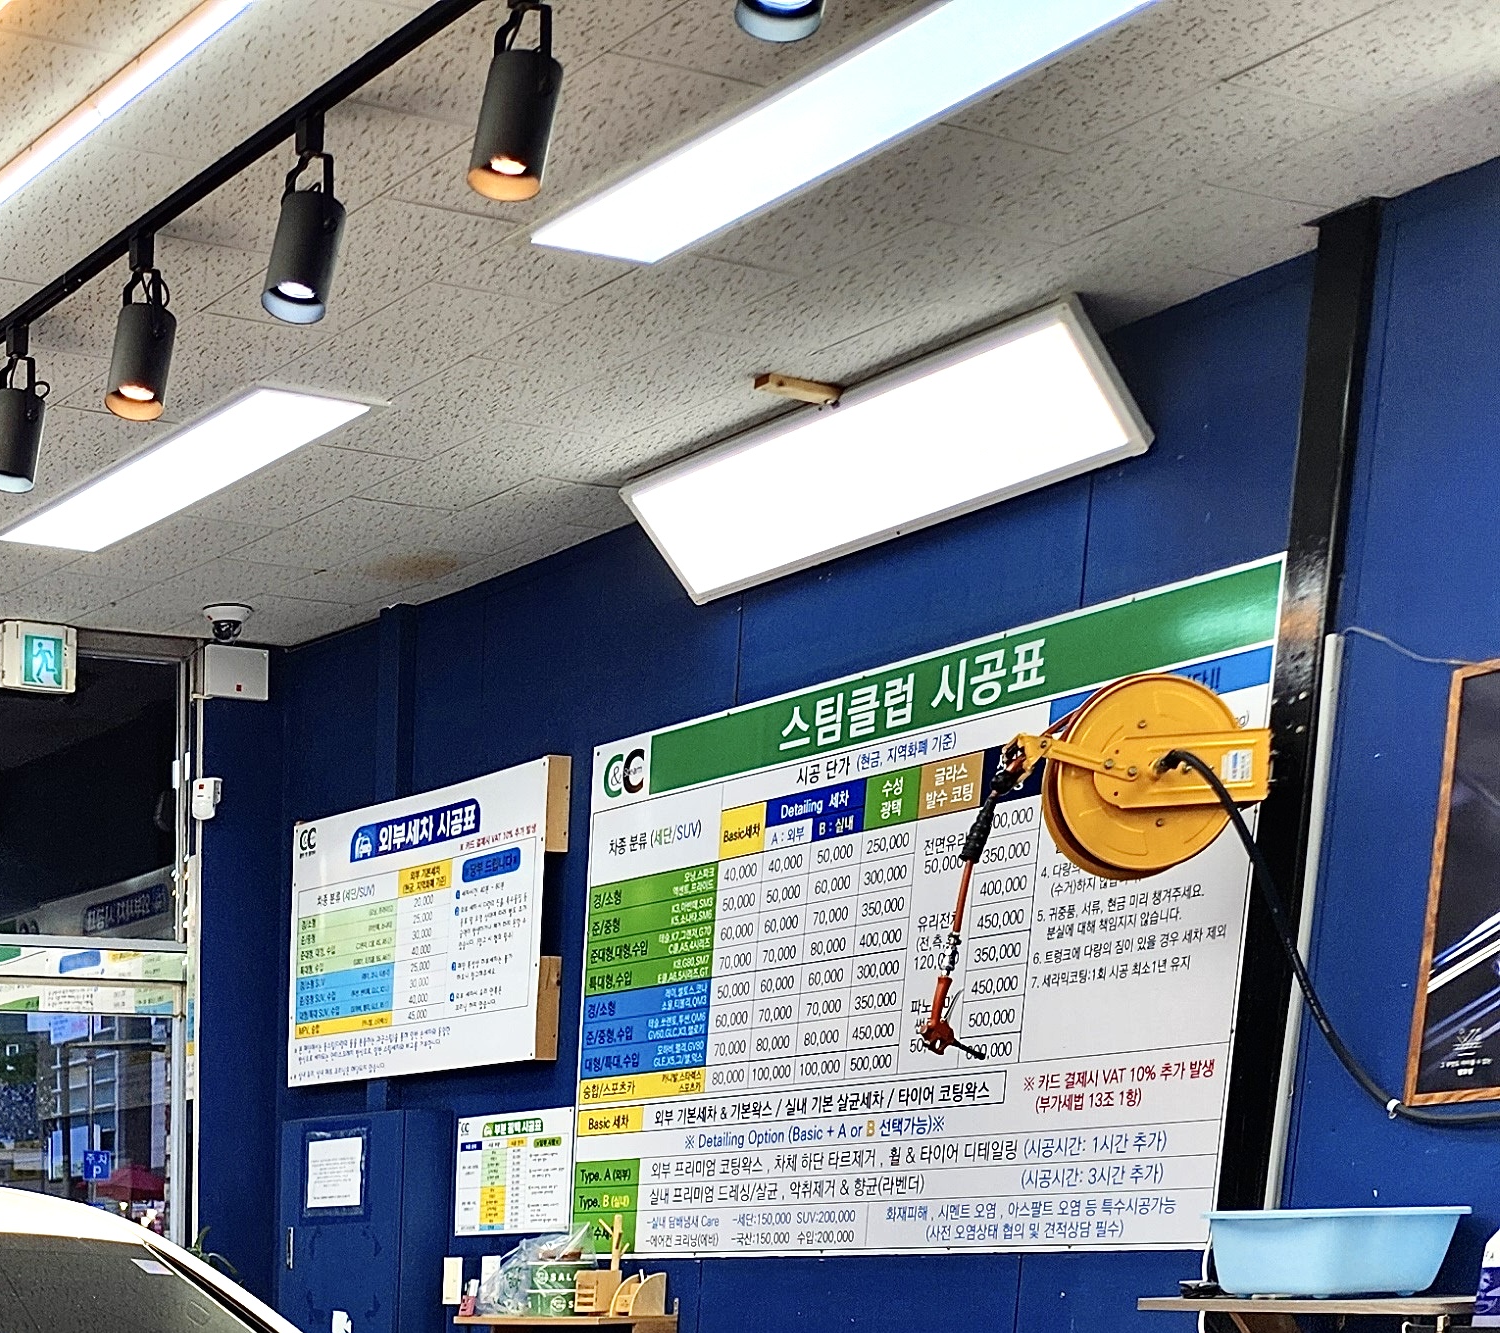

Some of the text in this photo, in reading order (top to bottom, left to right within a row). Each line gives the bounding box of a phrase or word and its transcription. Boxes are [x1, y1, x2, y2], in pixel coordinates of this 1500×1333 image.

[779, 639, 1045, 750] 스팀클럽 시공표
[797, 731, 957, 785] 시공 단가 (현금, 지역화폐 기준)
[935, 763, 969, 785] 글라스
[882, 777, 904, 797] 수성
[926, 783, 974, 809] 발수 코팅
[781, 790, 849, 819] Detailing 세차
[880, 798, 902, 819] 광택
[379, 803, 476, 852] 외부세차 시공표
[609, 819, 702, 857] 차종 분류 (세단/SUV)
[723, 823, 761, 844] Basic세차
[787, 826, 805, 842] 외부
[724, 832, 910, 882] 40,000 40,000 50,000 250,000
[722, 841, 1031, 912] 50,000 50,000 60,000 300,000 350,000
[720, 922, 754, 941] 60,000
[764, 914, 799, 934] 60,000
[813, 905, 849, 926] 70,000
[861, 896, 905, 918] 350,000
[980, 875, 1027, 896] 400,000
[1107, 892, 1149, 912] 현금 미리
[1077, 906, 1182, 934] 대해 책임지지 않습니다.
[719, 908, 1025, 970] 70,000 70,000 80,000 400,000 450,000
[1045, 923, 1228, 964] 트렁크에 다량의 짐이 있을 경우 세차 제외
[717, 942, 1022, 999] 50,000 60,000 60,000 300,000 350,000
[1109, 954, 1191, 979] 시공 유지
[715, 975, 1019, 1028] 60,000 70,000 70,000 350,000 450,000
[714, 1039, 747, 1057] 70,000
[756, 1034, 790, 1053] 80,000
[804, 1029, 839, 1047] 80,000
[852, 1022, 895, 1041] 450,000
[968, 1008, 1016, 1028] 500,000
[712, 1068, 745, 1086] 80,000
[752, 1064, 791, 1082] 100,000
[799, 1059, 840, 1076] 100,000
[850, 1053, 892, 1072] 500,000
[1038, 1058, 1215, 1091] 카드 결제시 VAT 10% 추가 발생
[588, 1081, 990, 1131] Basic 세차 외부 기본세차 기본왁스 실내 기본 살균세차 타이어 코팅왁스
[1035, 1087, 1142, 1114] (부가세법 13조 1항)
[698, 1131, 745, 1150] Detailing
[748, 1126, 785, 1146] Option
[788, 1125, 823, 1144] (Basic
[850, 1125, 863, 1138] or
[651, 1130, 1167, 1179] 외부 프리미엄 코팅왁스 차체 하단 타르제거 타이어 디테일링 (시공시간: 1시간 추가)
[93, 1165, 102, 1179] P
[649, 1162, 1164, 1205] 실내 프리미엄 드레싱/살균 악취제거 향균(라벤더) (시공시간: 3시간 추가)
[701, 1196, 1176, 1227] Care 화재피해 시멘트 오염 아스팔트 오염 특수시공가능
[926, 1219, 1124, 1242] (사전 오염상태 협의 견적상담 필수)
